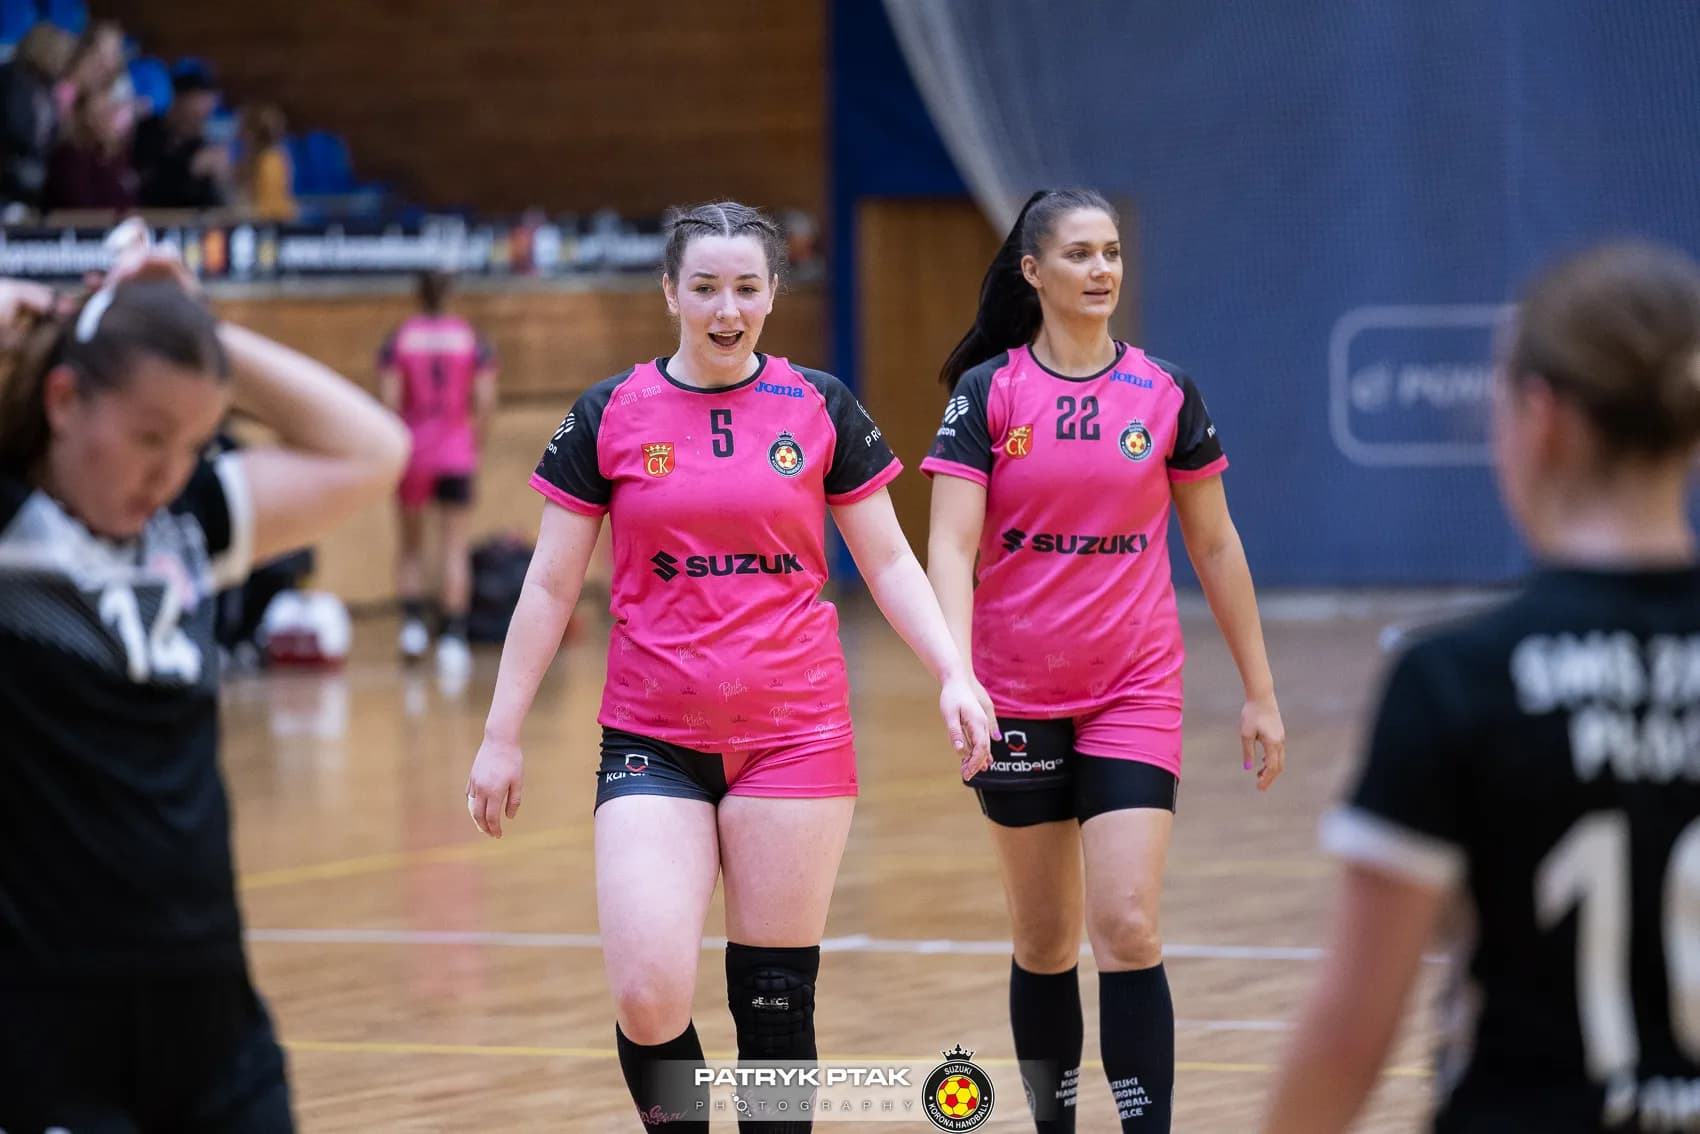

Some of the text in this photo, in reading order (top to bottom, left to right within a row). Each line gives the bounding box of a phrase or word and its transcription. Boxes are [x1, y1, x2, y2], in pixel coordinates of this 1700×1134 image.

[754, 381, 805, 398] Joma
[1110, 370, 1154, 389] Joma
[1056, 396, 1100, 440] 22
[710, 409, 734, 457] 5
[1005, 437, 1028, 455] CK
[647, 456, 670, 474] CK
[1031, 533, 1148, 555] SUZUKI
[685, 553, 804, 577] SUZUK
